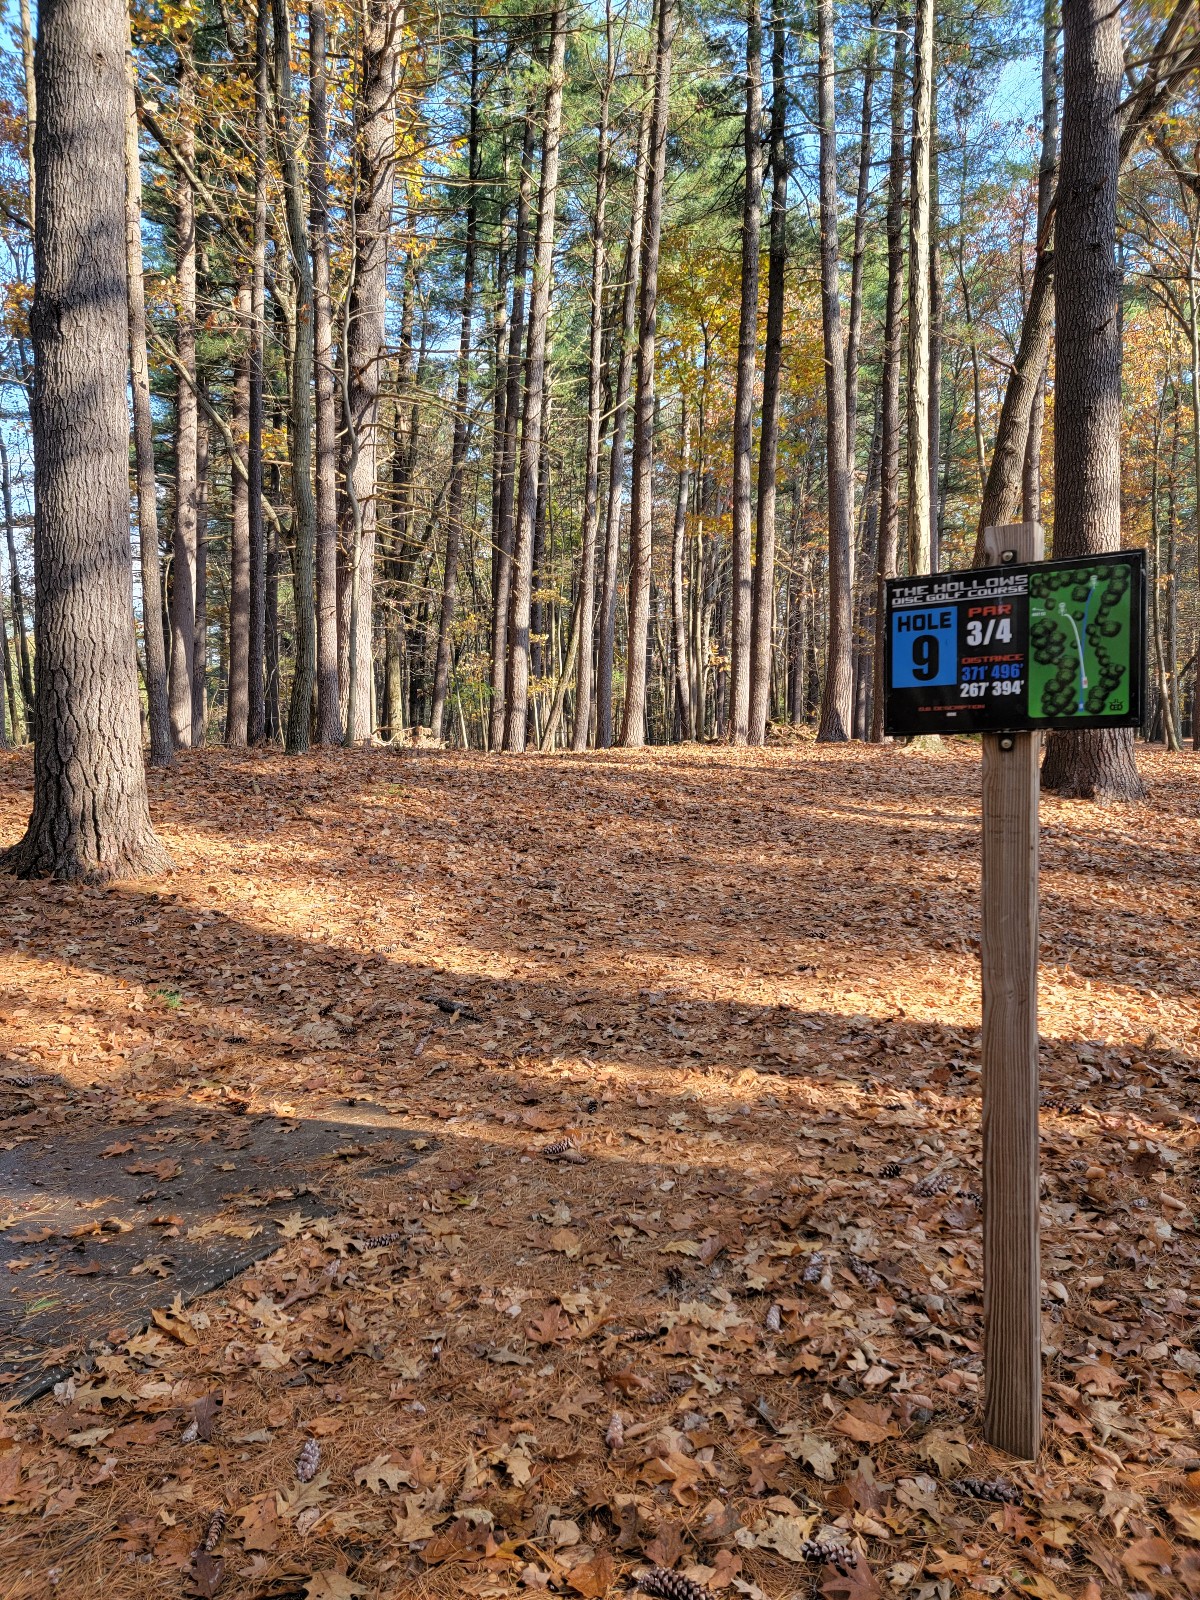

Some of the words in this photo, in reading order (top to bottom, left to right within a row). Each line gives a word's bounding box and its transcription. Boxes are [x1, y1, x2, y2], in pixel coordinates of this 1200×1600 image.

[892, 585, 929, 598] THE
[934, 574, 1029, 594] HOLLOWS
[892, 595, 923, 606] DISC
[926, 591, 964, 602] GOLF
[967, 584, 1029, 598] COURSE
[897, 611, 952, 633] HOLE
[968, 604, 1012, 618] PAR
[966, 618, 1012, 647] 3/4
[912, 634, 939, 681] 9
[961, 653, 1024, 665] DISTANCE
